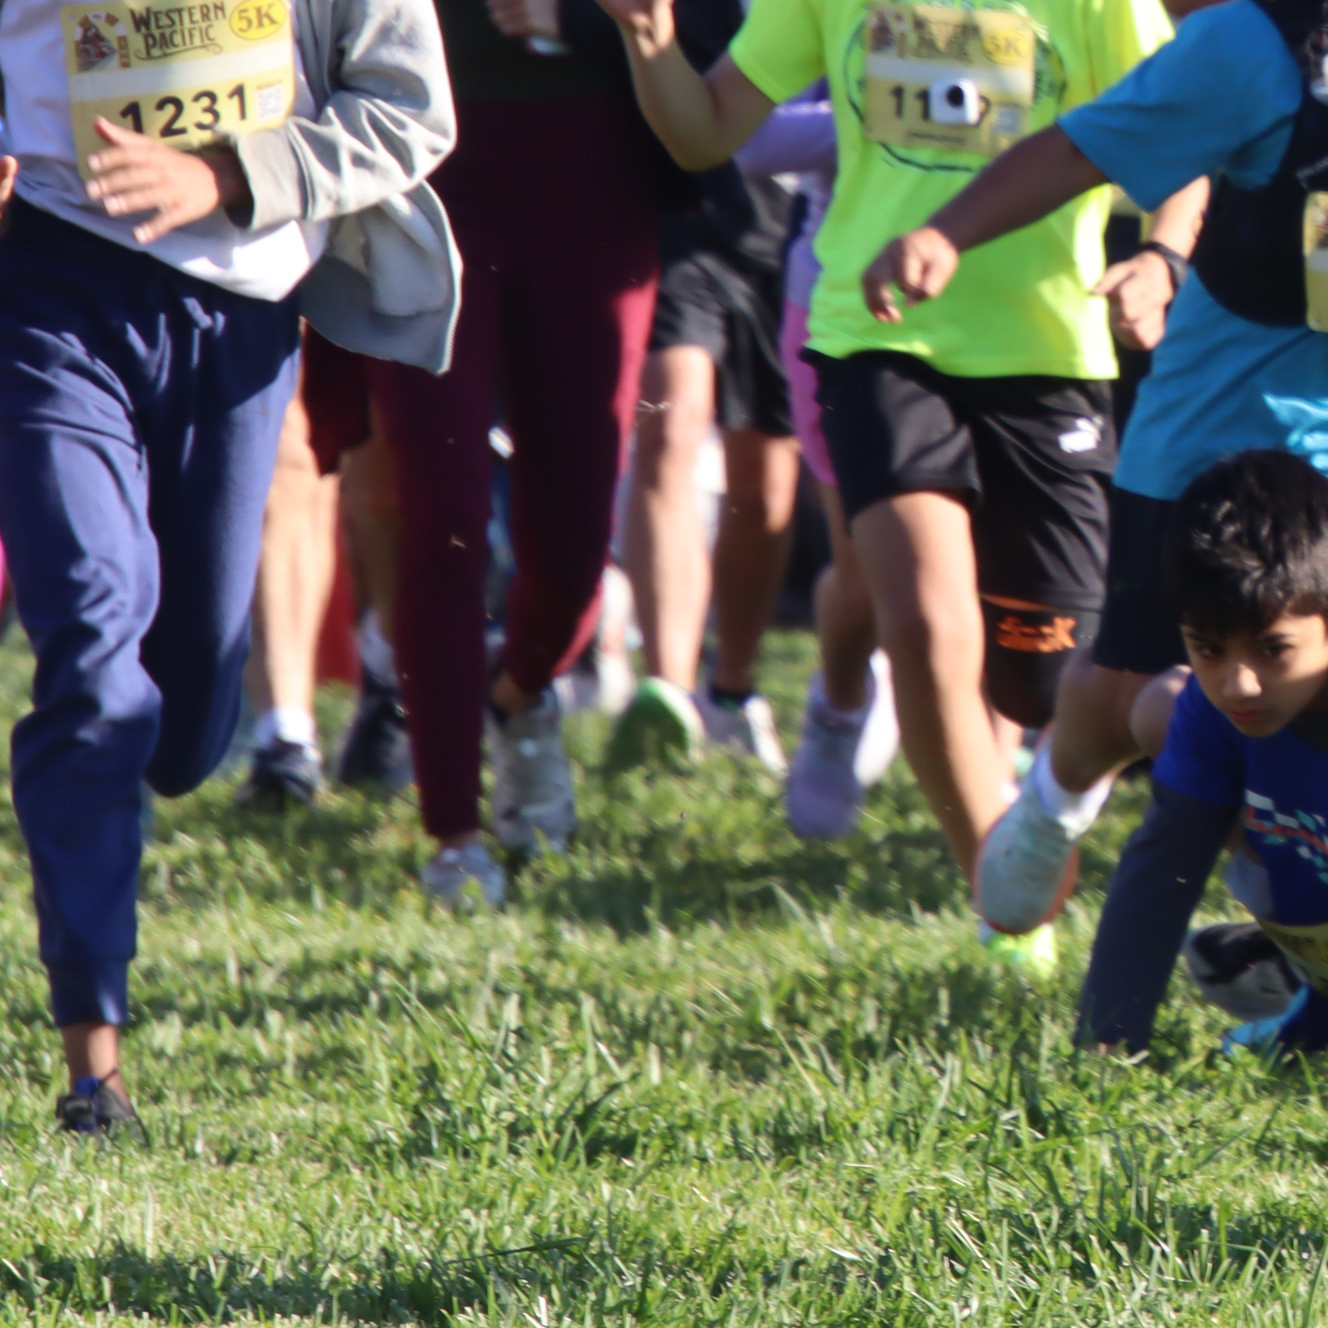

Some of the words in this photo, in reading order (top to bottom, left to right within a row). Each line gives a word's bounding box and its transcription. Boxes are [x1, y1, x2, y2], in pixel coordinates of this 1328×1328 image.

[129, 1, 226, 33] WESTERN
[237, 3, 279, 33] 5K
[143, 24, 215, 57] PACIFIC
[120, 82, 248, 138] 1231
